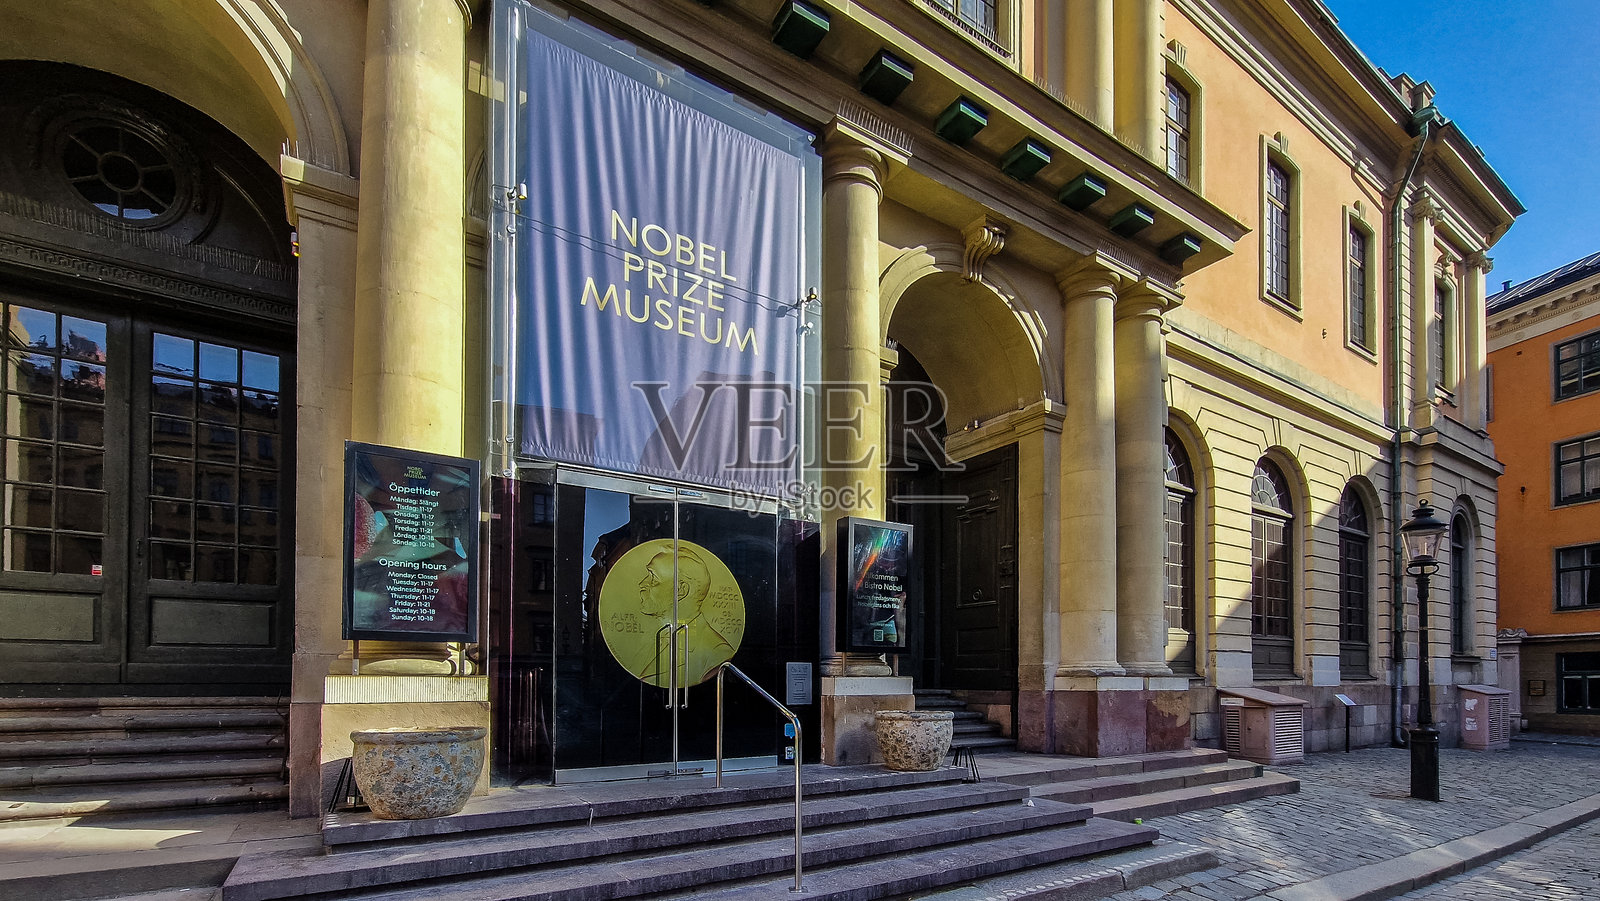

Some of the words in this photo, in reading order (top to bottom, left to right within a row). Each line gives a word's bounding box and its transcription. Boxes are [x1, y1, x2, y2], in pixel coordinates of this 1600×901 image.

[611, 209, 737, 282] NOBEL
[624, 251, 725, 312] PRIZE
[580, 276, 759, 356] MUSEUM
[404, 472, 426, 480] MUSEUM
[389, 482, 440, 497] Öppettider
[390, 495, 418, 505] Måndag:
[419, 499, 439, 507] Stängt
[396, 503, 419, 511] Tisdag:
[394, 510, 420, 519] Onsdag:
[394, 518, 420, 526] Torsdag:
[395, 525, 418, 533] Fredag:
[393, 531, 417, 540] Lördag:
[392, 538, 418, 547] Söndag:
[379, 558, 420, 570] Opening
[421, 560, 447, 571] hours
[388, 571, 417, 580] Monday:
[392, 578, 420, 587] Tuesday:
[865, 582, 883, 590] Bistro
[883, 583, 903, 592] Nobel
[386, 585, 425, 594] Wednesday:
[390, 592, 421, 601] Thursday:
[394, 599, 416, 608] Friday:
[389, 606, 419, 615] Saturday:
[391, 614, 417, 622] Sunday:
[604, 620, 645, 634] NOBEL
